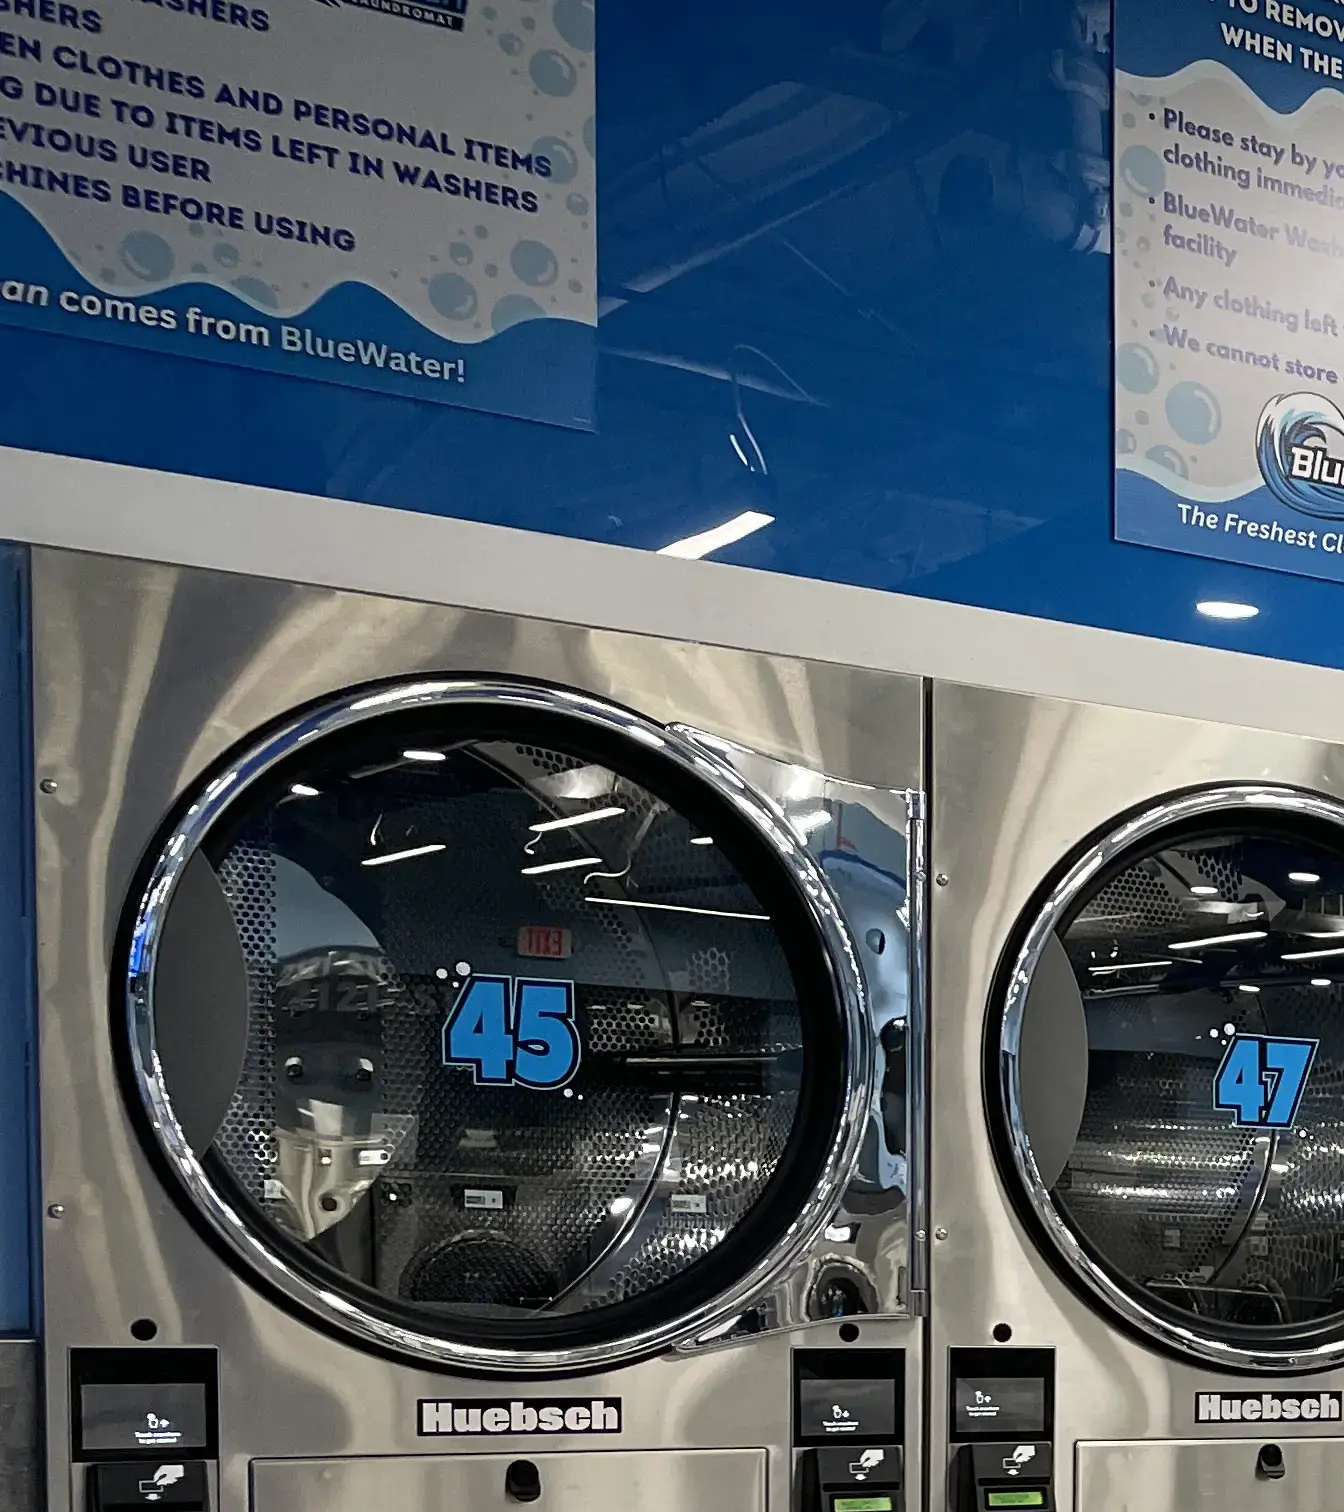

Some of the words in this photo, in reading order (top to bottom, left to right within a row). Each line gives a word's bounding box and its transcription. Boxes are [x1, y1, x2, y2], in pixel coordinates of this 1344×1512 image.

[1220, 22, 1292, 64] WHEN
[1299, 46, 1343, 79] THE
[34, 81, 101, 118] DUE
[110, 98, 154, 128] TO
[165, 111, 262, 152] ITEMS
[271, 134, 340, 169] LEFT
[347, 151, 384, 179] IN
[392, 160, 538, 213] WASHERS
[52, 45, 205, 99] CLOTHES
[214, 83, 283, 116] AND
[293, 98, 456, 156] PERSONAL
[463, 137, 552, 178] ITEMS
[1163, 107, 1234, 147] Please
[1239, 134, 1285, 166] stay
[1290, 142, 1317, 175] by
[128, 143, 211, 183] USER
[0, 160, 111, 203] HINES
[121, 184, 244, 230] BEFORE
[253, 211, 355, 252] USING
[58, 290, 177, 330] comes
[185, 306, 269, 346] from
[281, 325, 465, 383] BlueWater!
[1177, 502, 1218, 529] The
[1224, 512, 1317, 549] Freshest
[443, 975, 581, 1089] 45
[1215, 1035, 1315, 1128] 47
[421, 1401, 619, 1434] Huebsch
[1198, 1394, 1341, 1422] Huebsch
